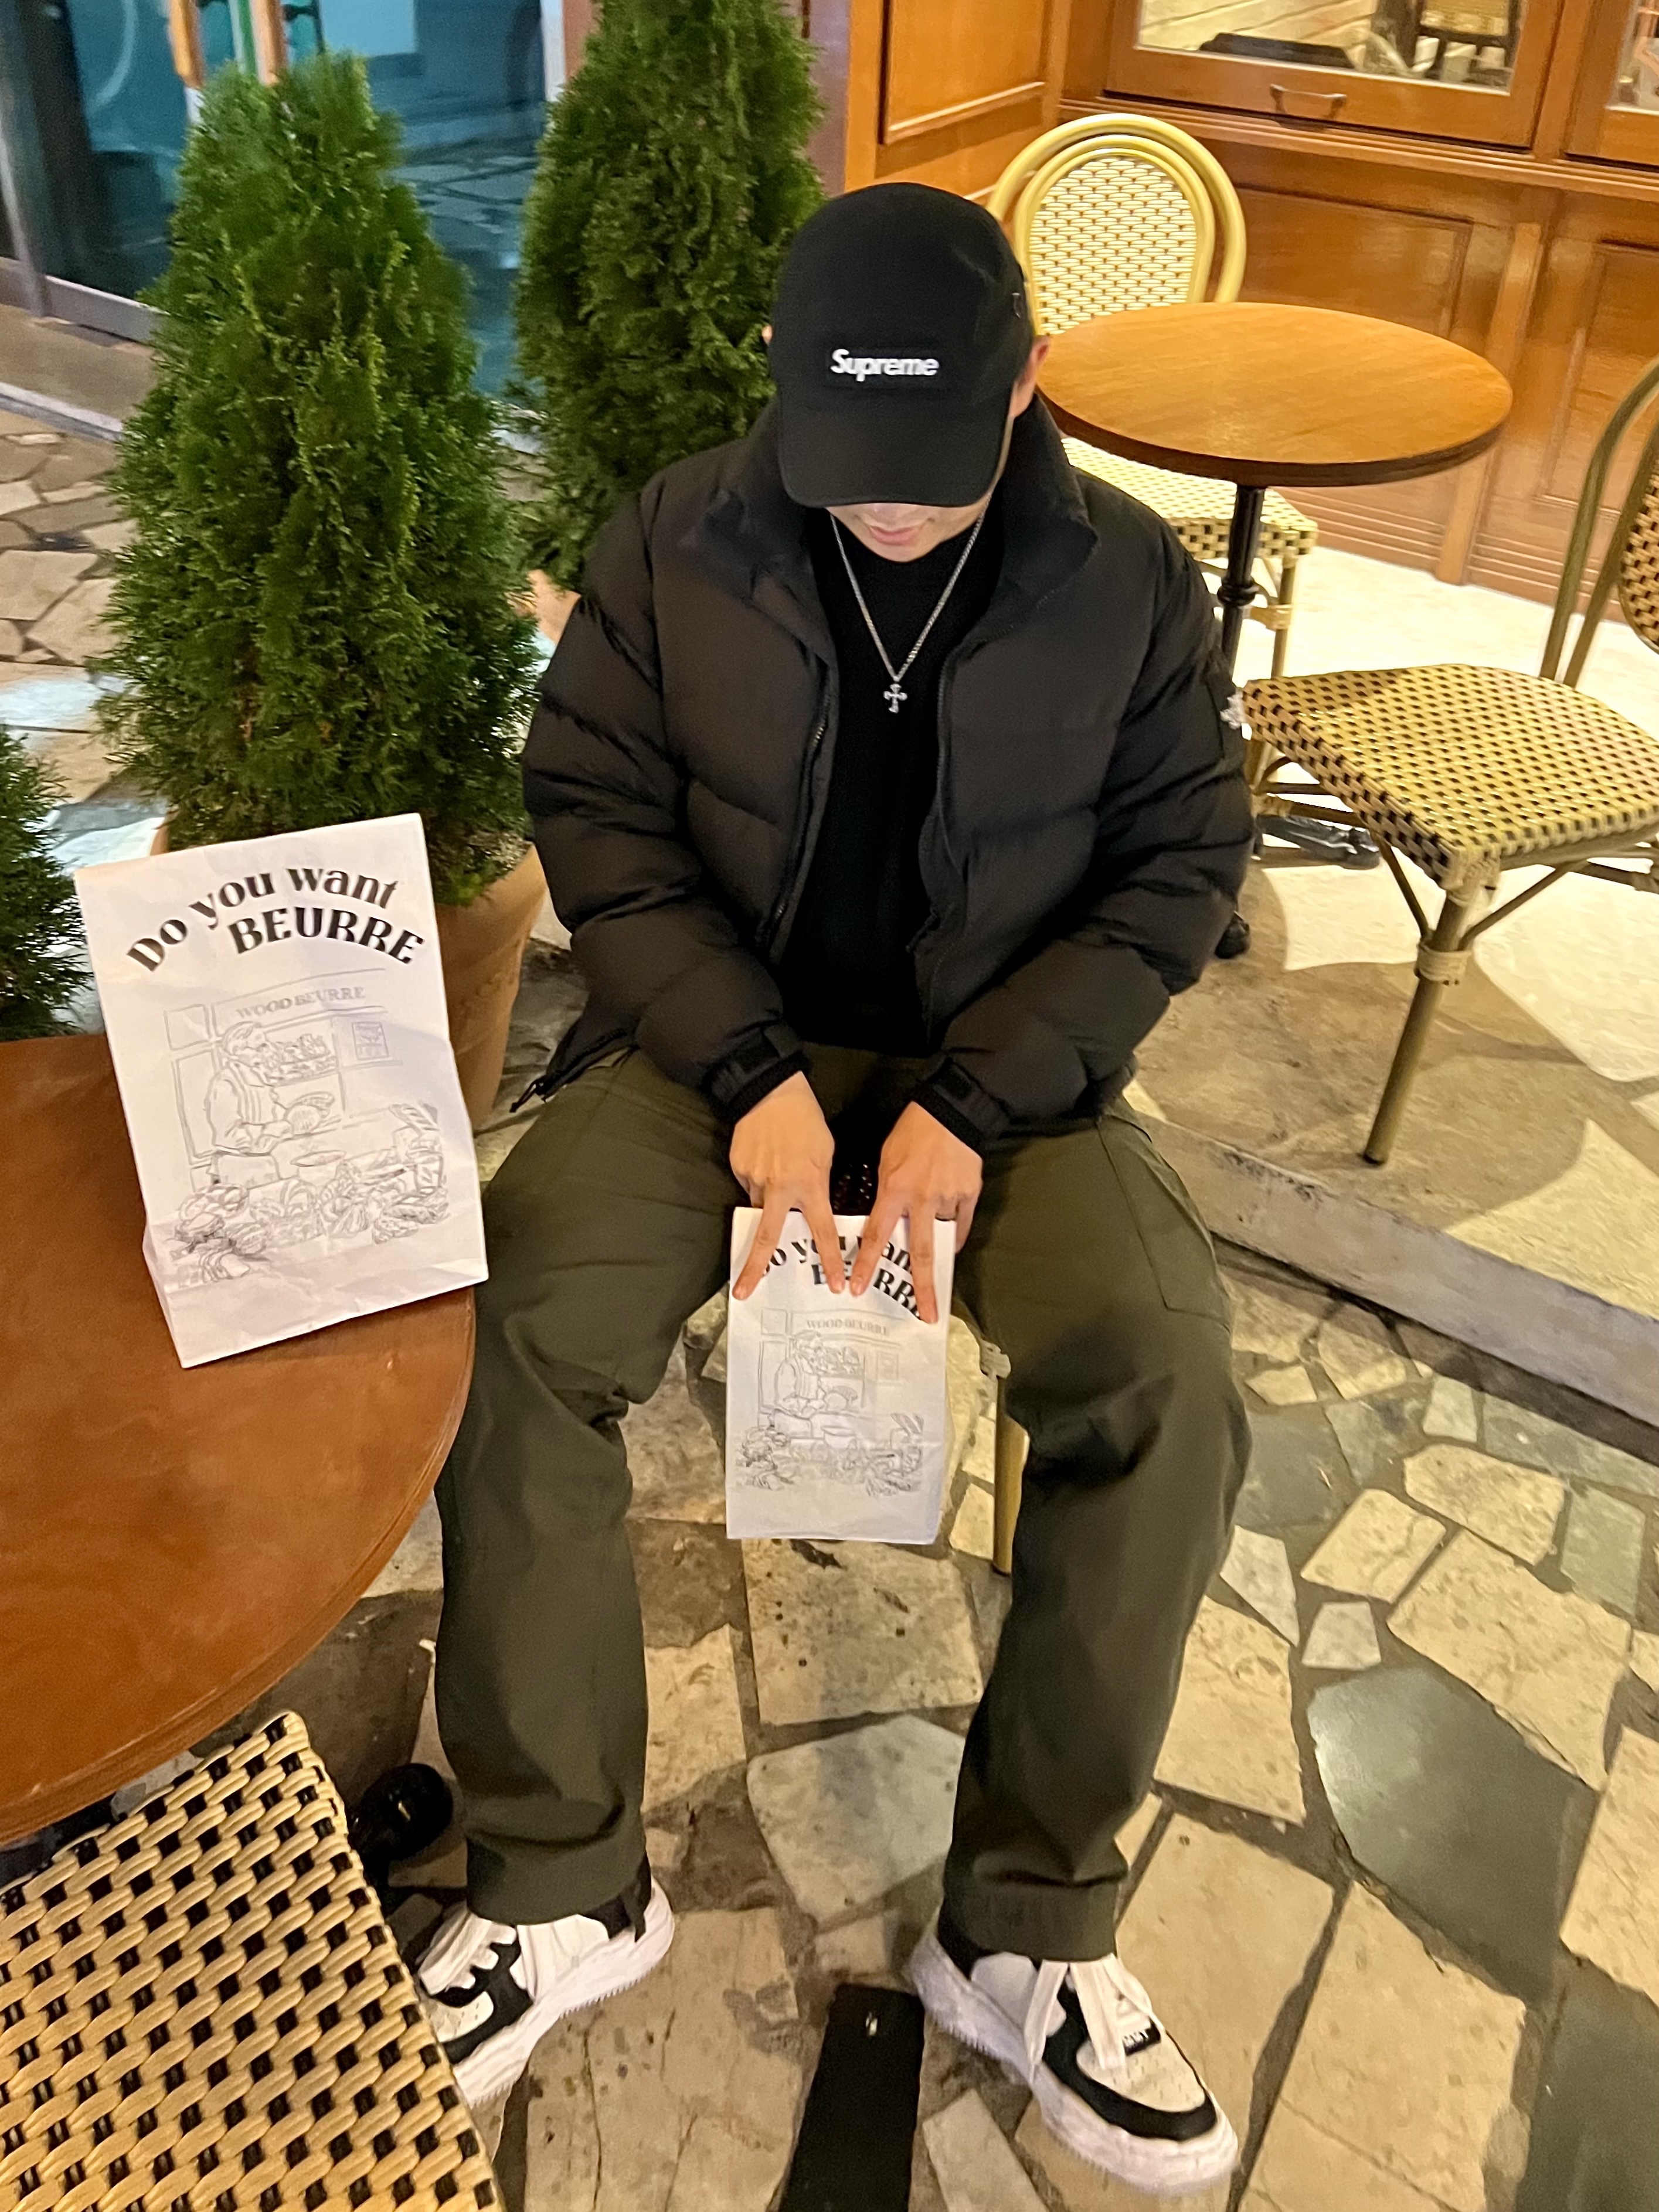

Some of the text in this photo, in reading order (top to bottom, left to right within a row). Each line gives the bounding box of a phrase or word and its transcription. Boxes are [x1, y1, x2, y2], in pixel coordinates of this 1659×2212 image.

[830, 348, 939, 382] Supreme
[126, 867, 399, 972] Do you want
[227, 906, 425, 964] BEURRE
[235, 986, 366, 1018] WOOD BEURRE
